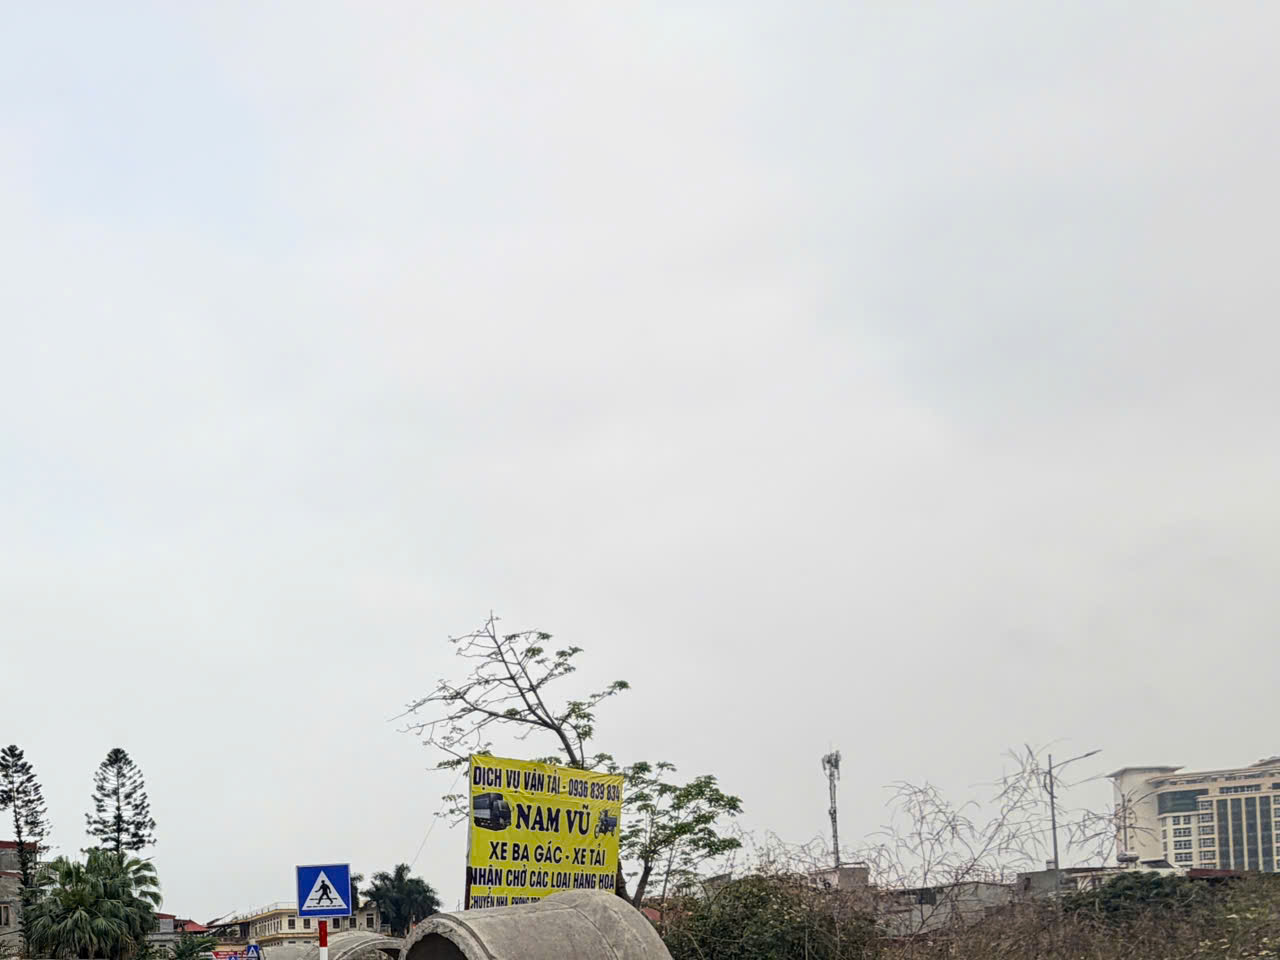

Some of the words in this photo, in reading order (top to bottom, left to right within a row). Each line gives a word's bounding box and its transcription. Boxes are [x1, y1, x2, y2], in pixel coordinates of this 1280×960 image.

[473, 766, 502, 790] DỊCH
[506, 769, 520, 793] VỤ
[524, 768, 544, 795] VẬN
[547, 769, 560, 795] TẢI
[568, 778, 588, 798] 0936
[516, 804, 560, 832] NAM
[566, 804, 590, 835] VŨ
[489, 841, 507, 860] XE
[512, 843, 529, 861] BA
[534, 840, 562, 864] GÁC
[572, 848, 587, 865] XE
[470, 865, 502, 891] NHẬN
[529, 867, 548, 887] CÁC
